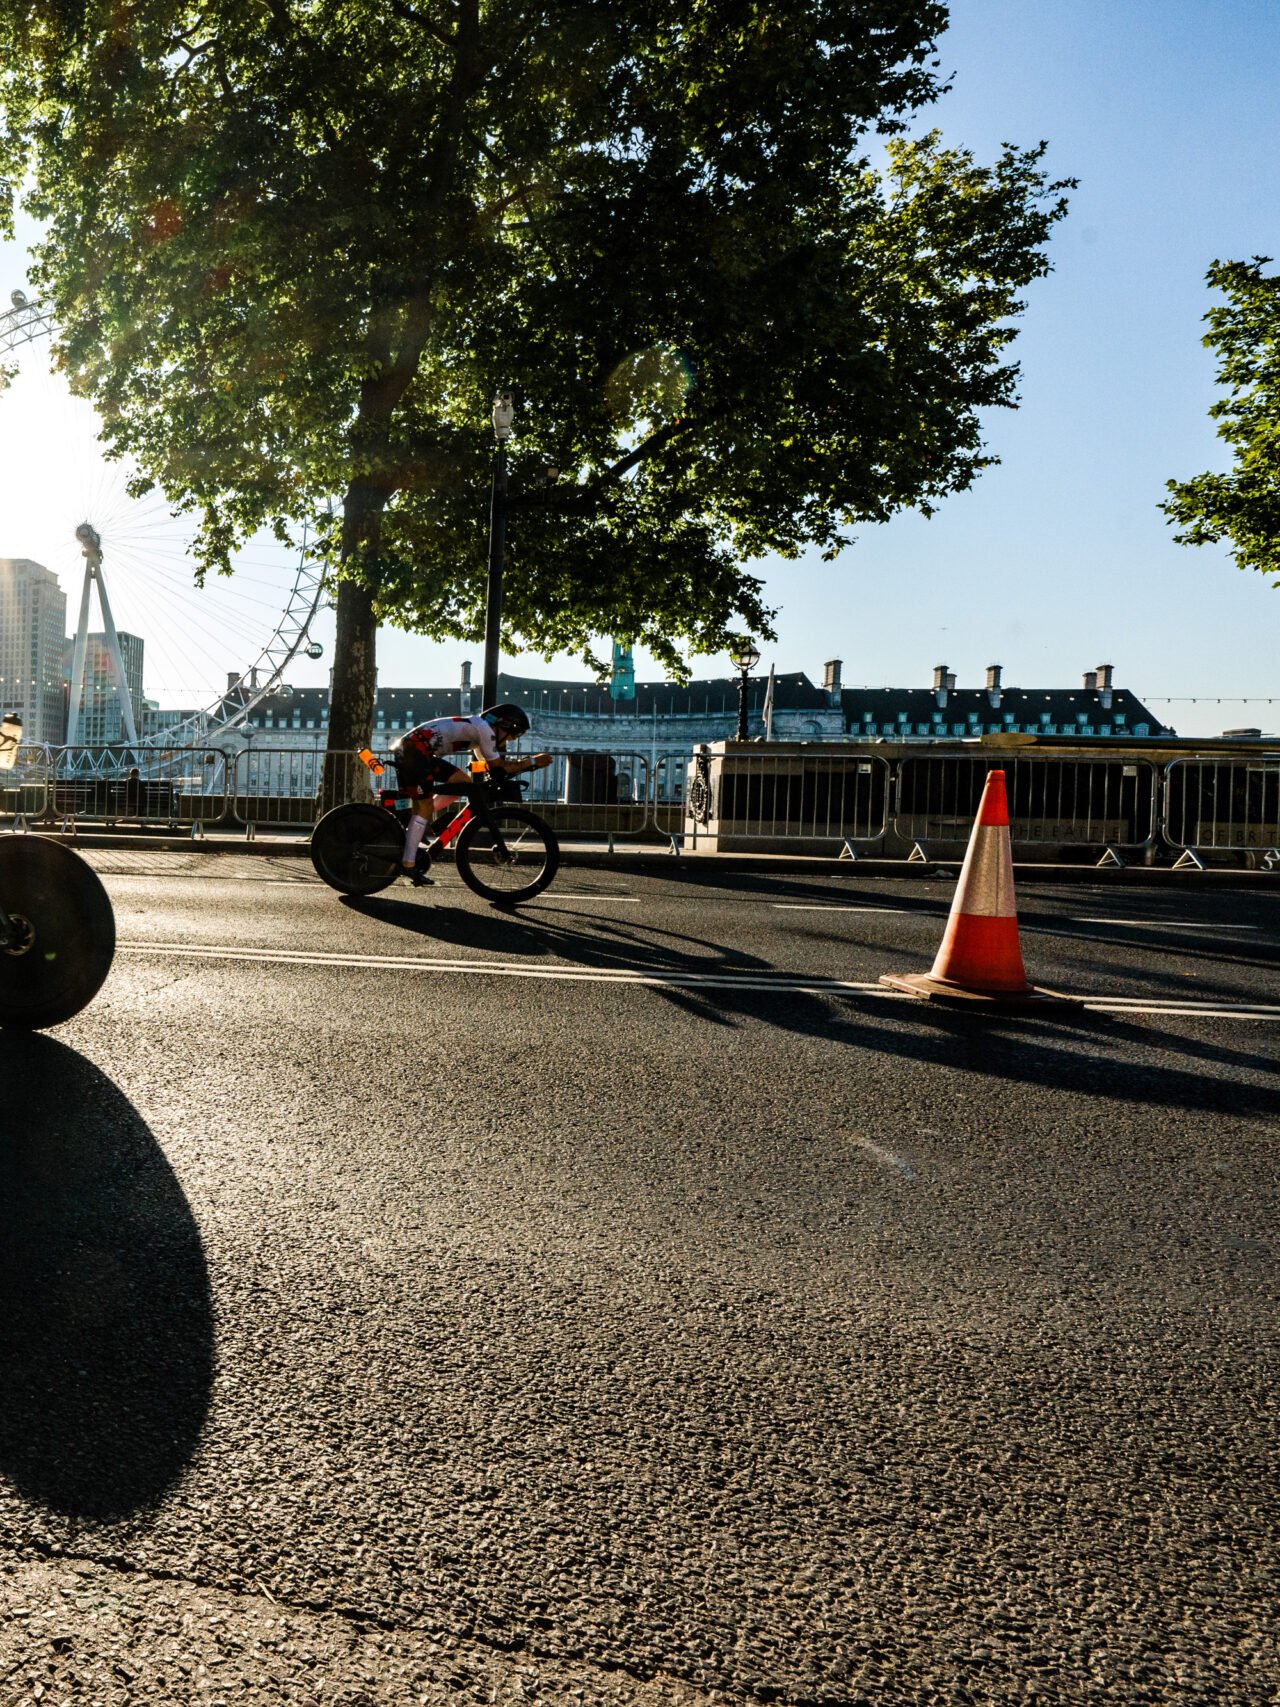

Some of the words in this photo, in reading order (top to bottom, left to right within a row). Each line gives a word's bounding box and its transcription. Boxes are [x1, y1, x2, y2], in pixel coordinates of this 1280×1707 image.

[1011, 824, 1041, 837] HE
[1202, 829, 1225, 841] OF
[1236, 830, 1277, 843] BRT
